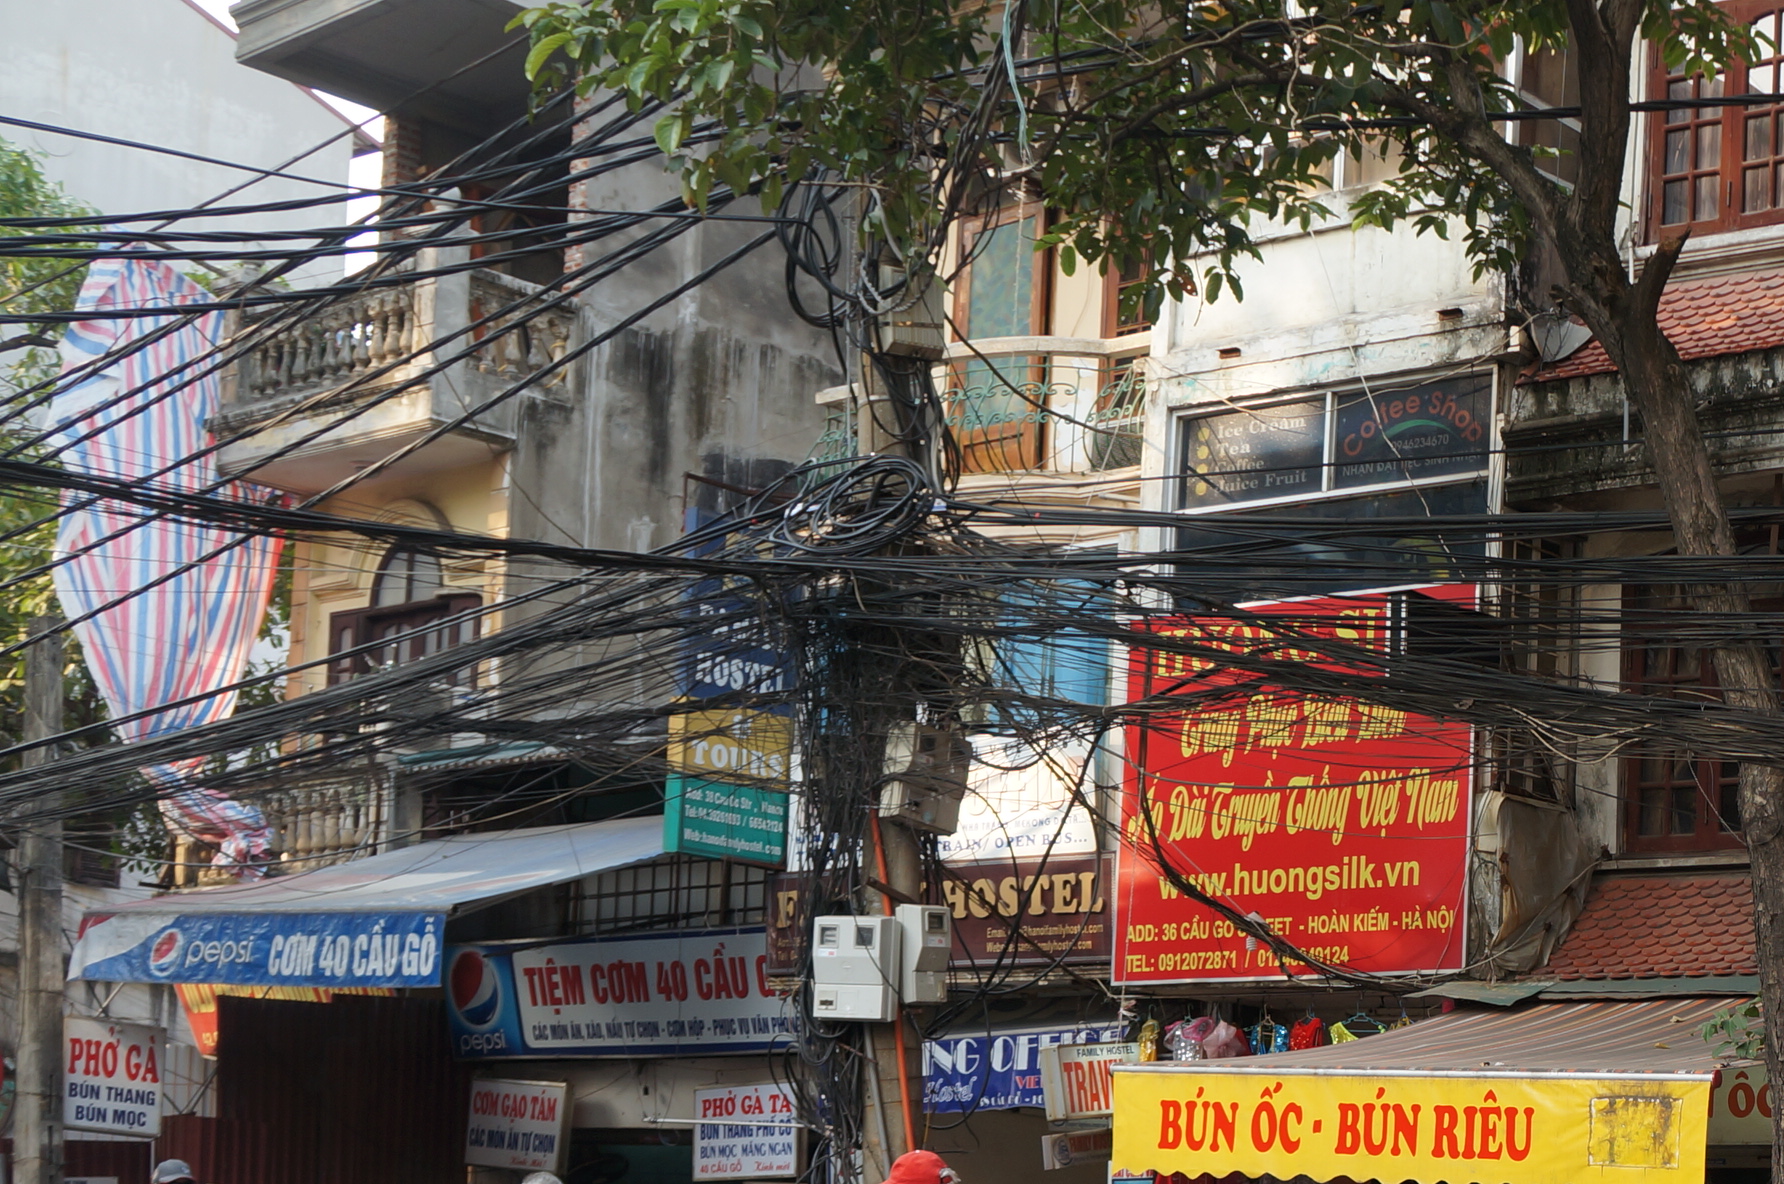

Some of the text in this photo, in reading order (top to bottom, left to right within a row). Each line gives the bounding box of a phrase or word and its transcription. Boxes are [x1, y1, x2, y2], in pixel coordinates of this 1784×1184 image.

[1217, 418, 1307, 439] Ice Cream
[1428, 390, 1483, 442] Shop
[1216, 443, 1250, 455] Tea
[1215, 460, 1265, 474] Coffee
[1217, 470, 1307, 492] Juice Fruit
[691, 738, 784, 778] TOURS
[1168, 784, 1208, 844] Dài
[1211, 770, 1283, 852] Truyền
[1286, 765, 1353, 846] Thống
[1405, 766, 1460, 831] Nam
[994, 834, 1036, 849] OPEN
[942, 872, 1104, 919] HOSTEL
[1127, 902, 1455, 944] ADD: 36 CẦU HOÀN KIẾM HÀ NỘI
[185, 936, 255, 968] pepsi
[267, 931, 321, 977] CƠM
[318, 934, 350, 977] 40
[401, 916, 437, 977] GỖ
[1126, 950, 1237, 972] TEL: 0912072871
[524, 957, 586, 1016] TIỆM
[589, 958, 650, 1005] CƠM
[656, 957, 688, 1002] 40
[694, 942, 750, 1001] CẦU
[68, 1026, 160, 1084] PHỞ GÀ
[460, 1028, 506, 1054] pepsi
[1076, 1045, 1135, 1058] FAMILY HOSTEL
[68, 1081, 156, 1106] BÚN THANG
[1015, 1075, 1044, 1090] VIE
[1062, 1058, 1123, 1113] TRAV
[75, 1103, 147, 1130] BÚN MỌC
[472, 1089, 557, 1124] CƠM GẠO TÁM
[701, 1090, 736, 1119] PHỞ
[768, 1093, 792, 1114] TA
[1158, 1087, 1239, 1152] BÚN
[1250, 1081, 1303, 1155] ỐC
[1335, 1087, 1421, 1156] BÚN
[1432, 1090, 1535, 1162] RIÊU
[768, 1141, 793, 1157] NGAN
